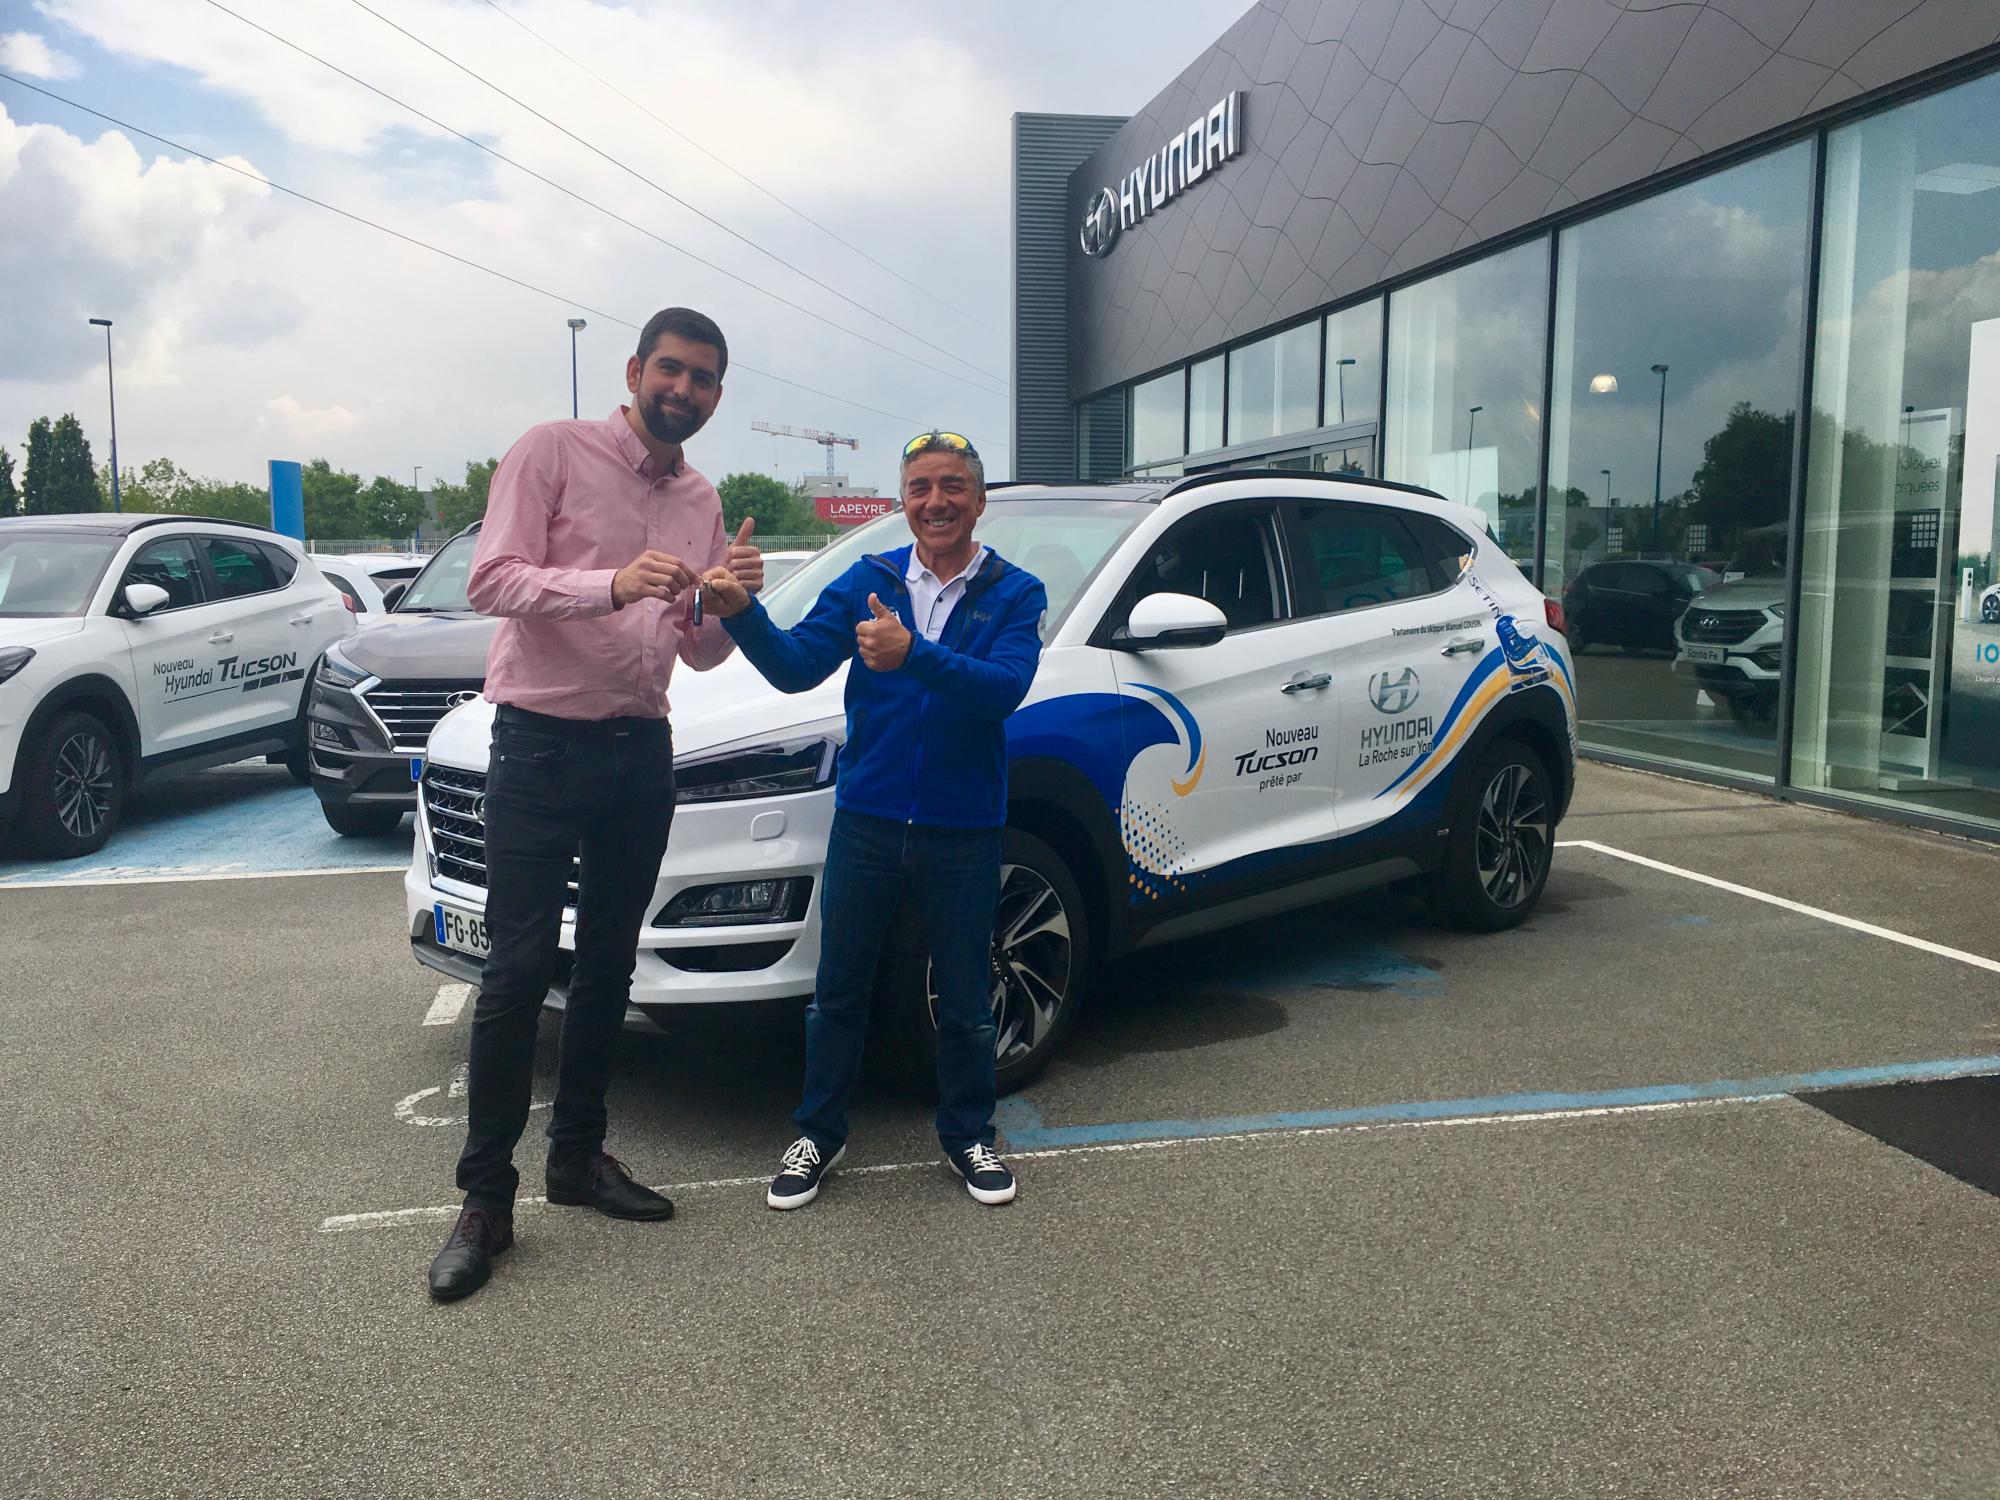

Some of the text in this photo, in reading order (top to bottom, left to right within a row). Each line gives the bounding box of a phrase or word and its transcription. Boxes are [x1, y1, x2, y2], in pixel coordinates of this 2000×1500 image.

[1120, 90, 1239, 231] HYUNDAI
[830, 503, 886, 514] LAPEYRE
[153, 659, 194, 675] Nouveau
[1709, 651, 1719, 661] Fe
[165, 668, 213, 695] Hyundai
[1266, 725, 1319, 748] Nouveau
[1361, 716, 1433, 750] HYUNDAI
[1358, 740, 1433, 767] La Roche sur Yon
[1259, 772, 1303, 792] prêté par
